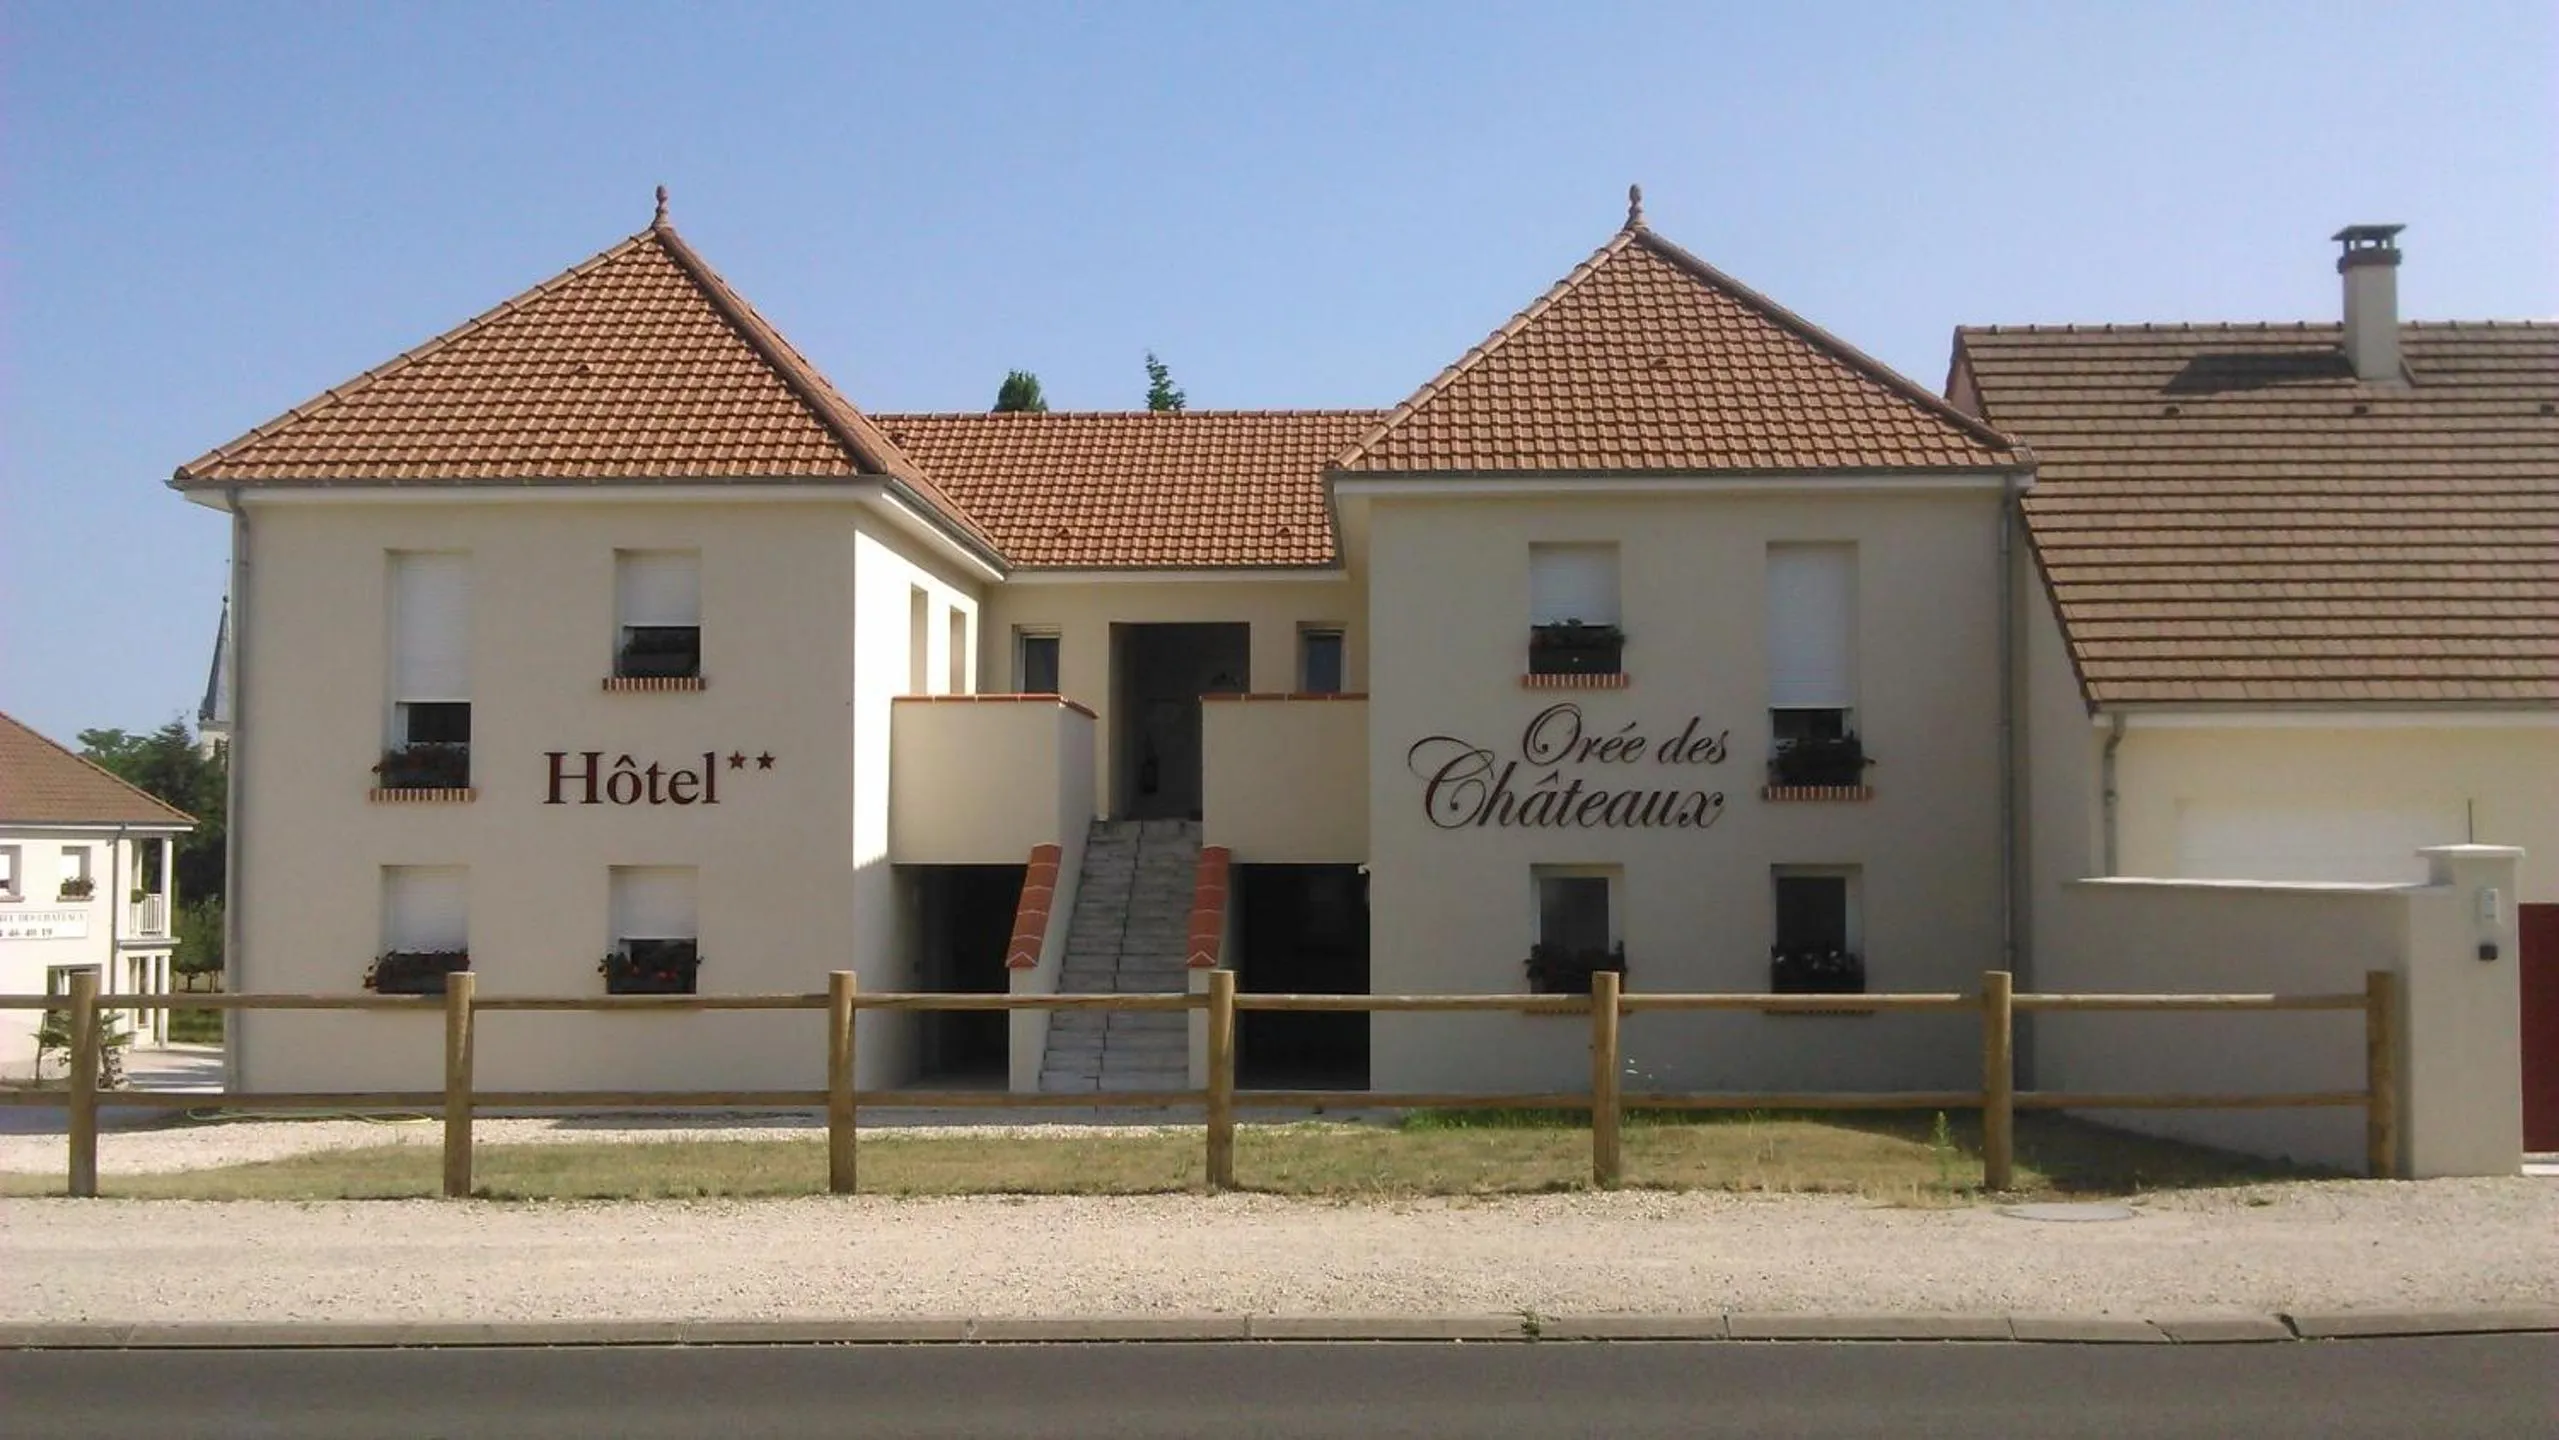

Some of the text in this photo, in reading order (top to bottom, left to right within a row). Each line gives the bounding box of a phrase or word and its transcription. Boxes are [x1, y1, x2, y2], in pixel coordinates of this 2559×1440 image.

[1523, 702, 1729, 766] Orée des
[543, 751, 721, 805] Hôtel
[1408, 735, 1725, 828] Châteaux
